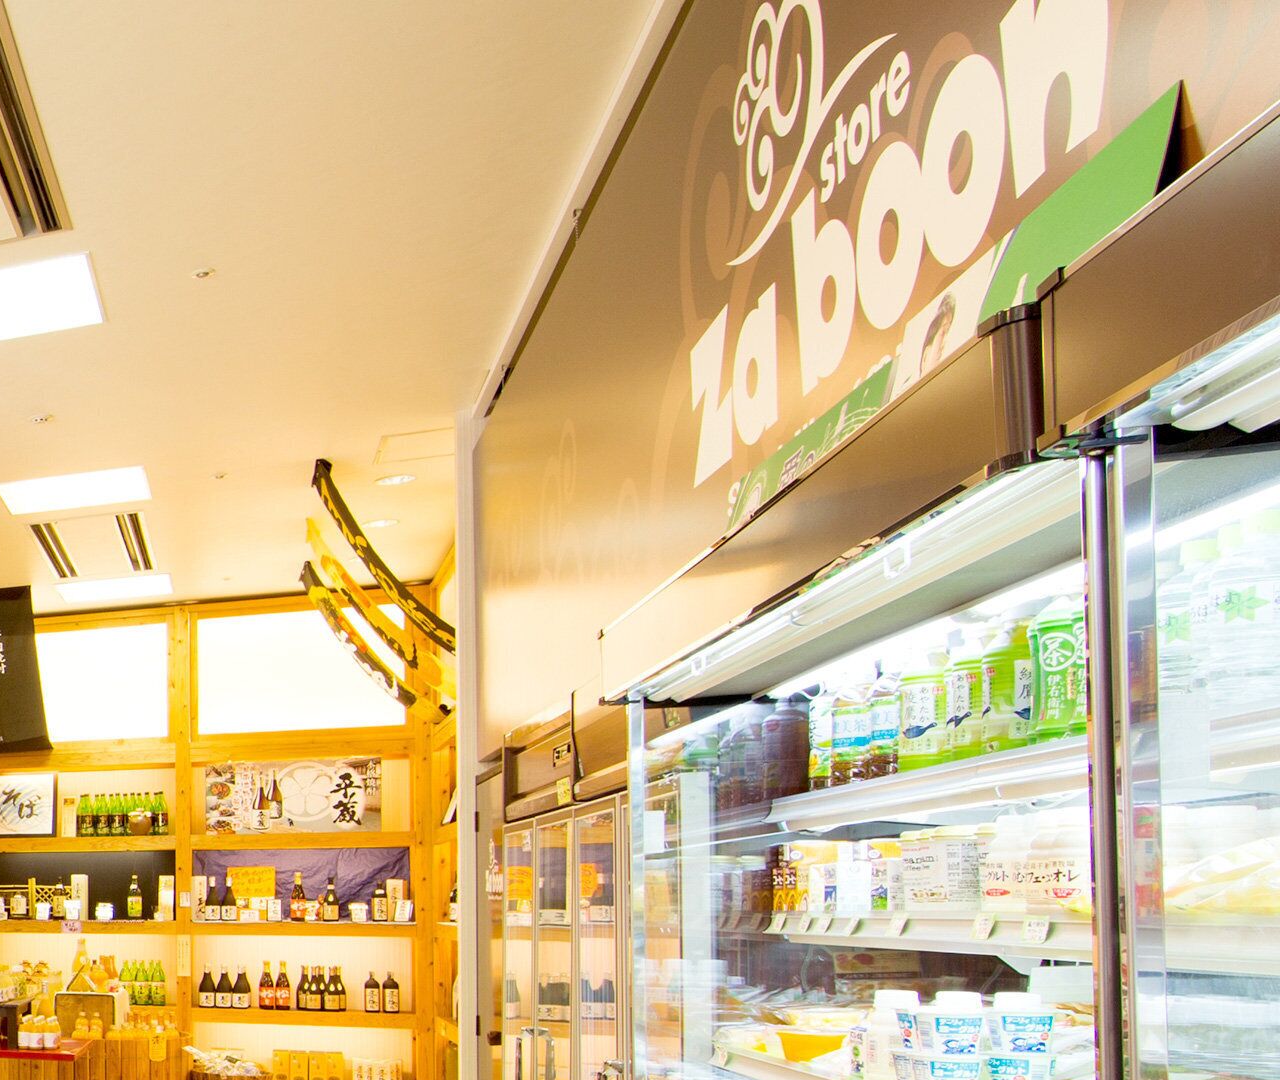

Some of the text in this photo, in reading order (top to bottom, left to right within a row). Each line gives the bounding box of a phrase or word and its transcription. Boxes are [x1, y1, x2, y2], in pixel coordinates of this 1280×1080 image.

[820, 49, 910, 203] store
[791, 0, 1108, 397] boon
[2, 787, 43, 820] そば
[330, 772, 363, 827] 平蔵
